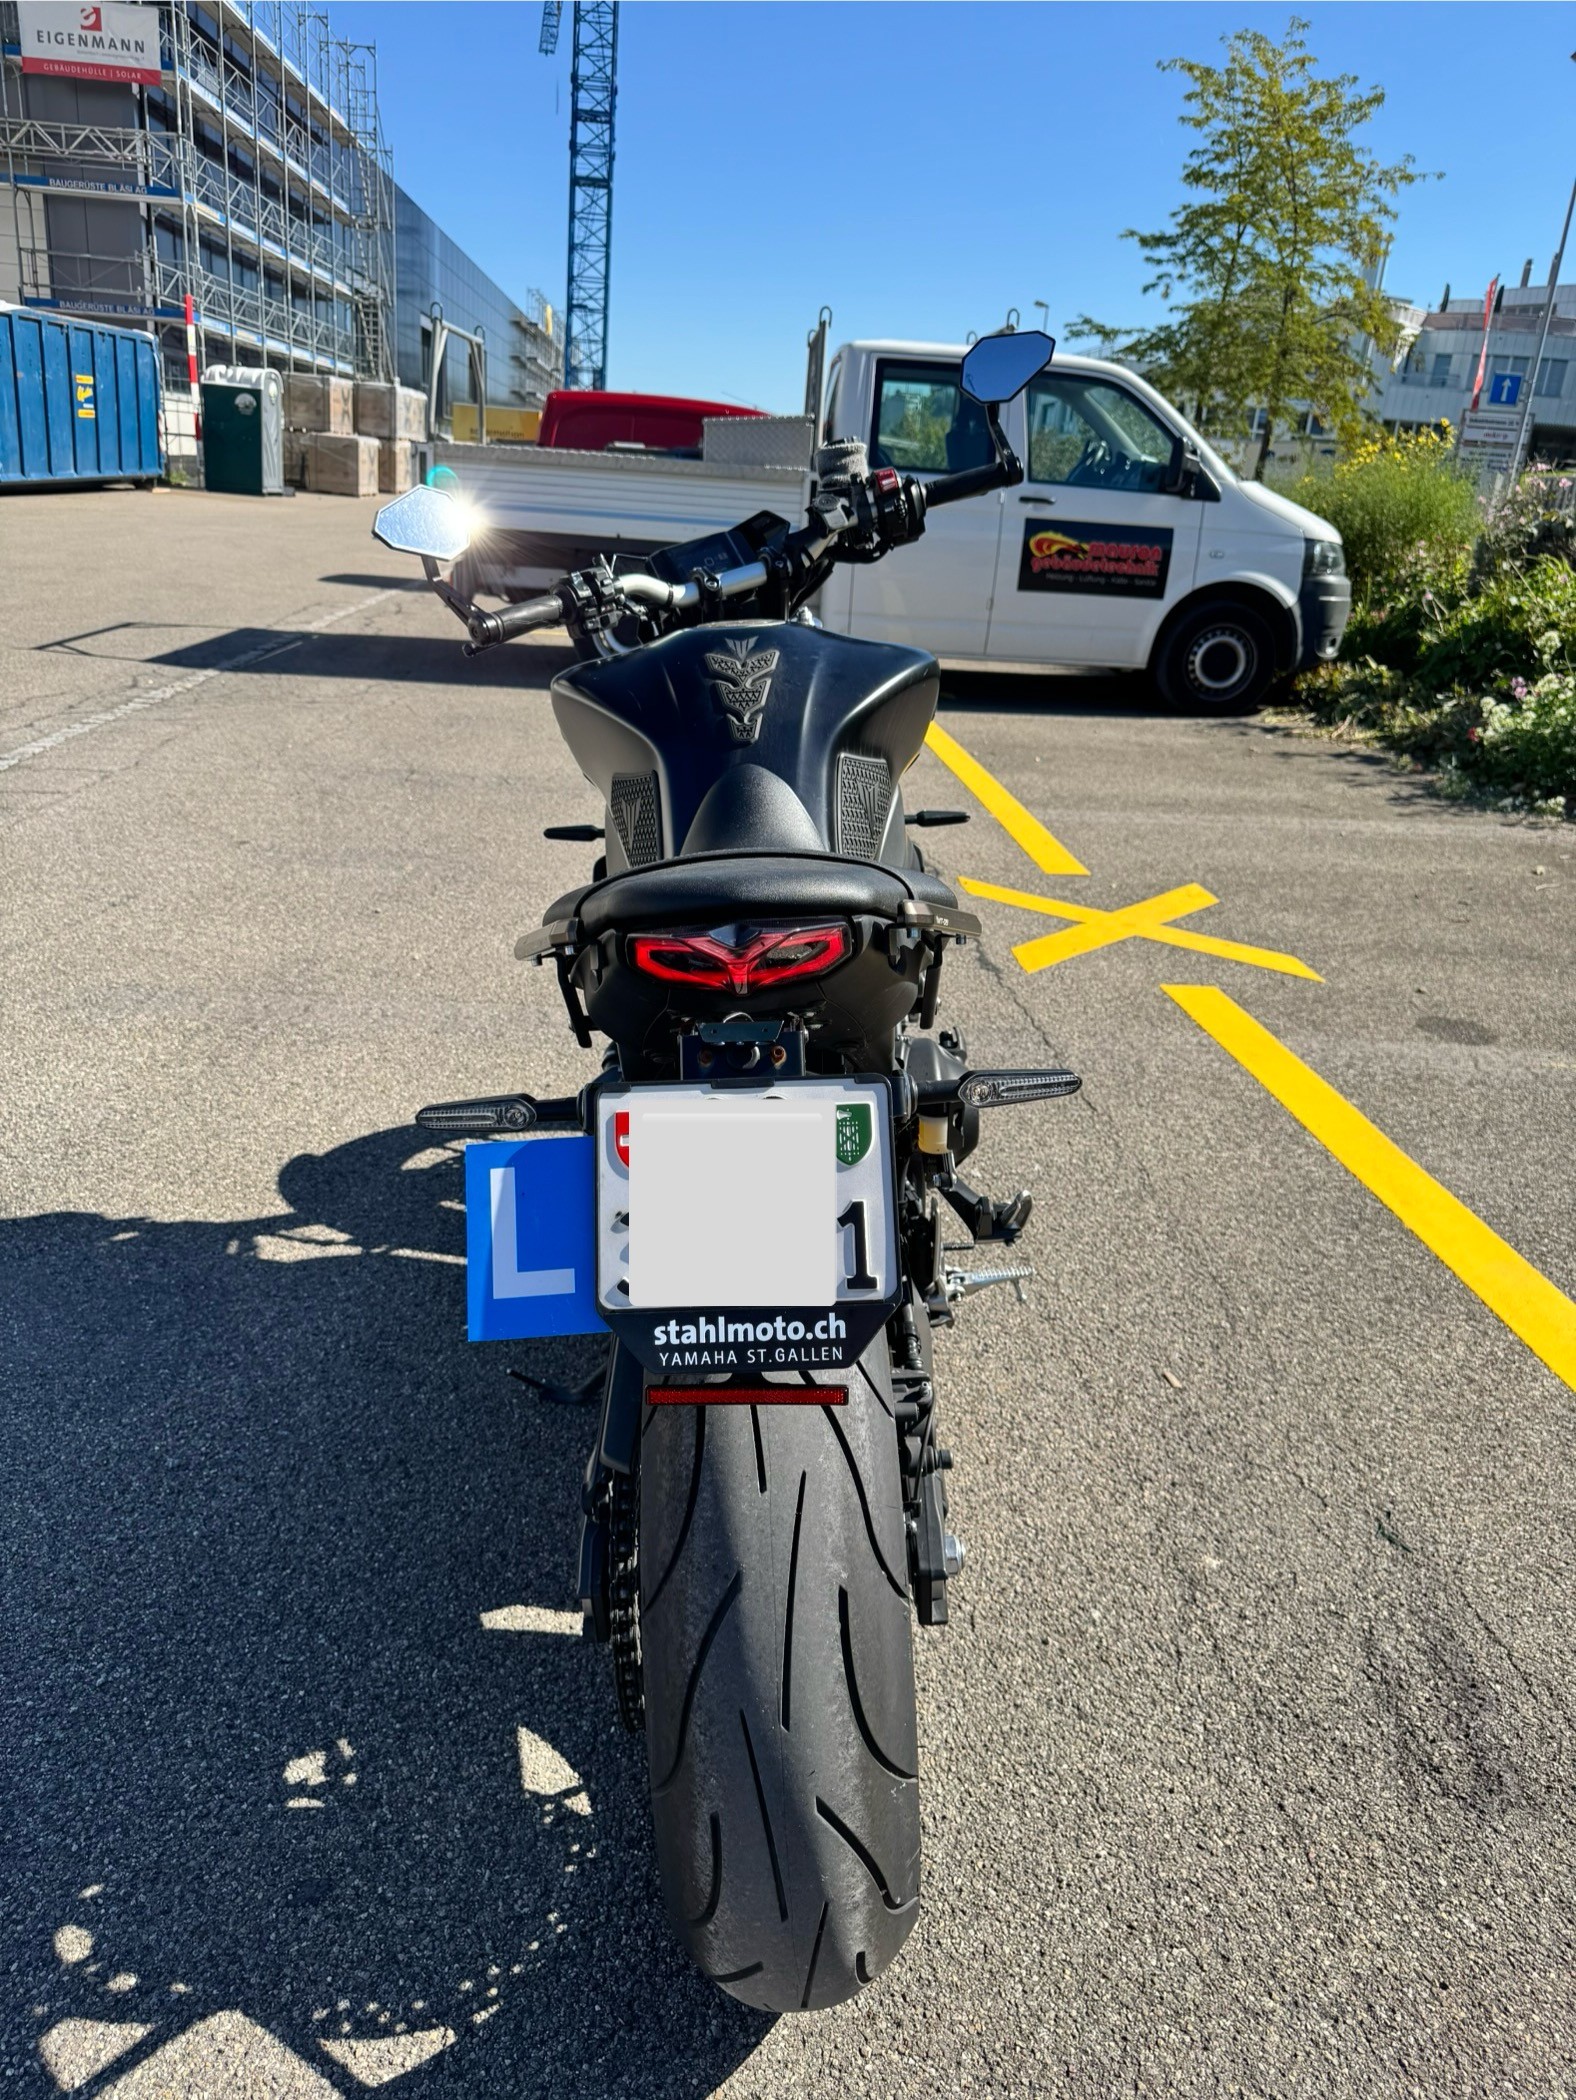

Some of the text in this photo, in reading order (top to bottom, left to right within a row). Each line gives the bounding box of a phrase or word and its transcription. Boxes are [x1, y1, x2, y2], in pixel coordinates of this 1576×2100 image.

[37, 30, 145, 53] EIGENMANN
[43, 62, 142, 80] GEBÄUDEHÜLLE SOLAR
[49, 178, 106, 191] BAUGERÜSTE
[135, 186, 148, 195] AG
[59, 301, 114, 314] BAUGERÜSTE
[490, 1167, 576, 1299] L
[654, 1312, 847, 1346] stahlmoto.ch
[659, 1346, 843, 1367] YAMAHA ST.GALLEN
